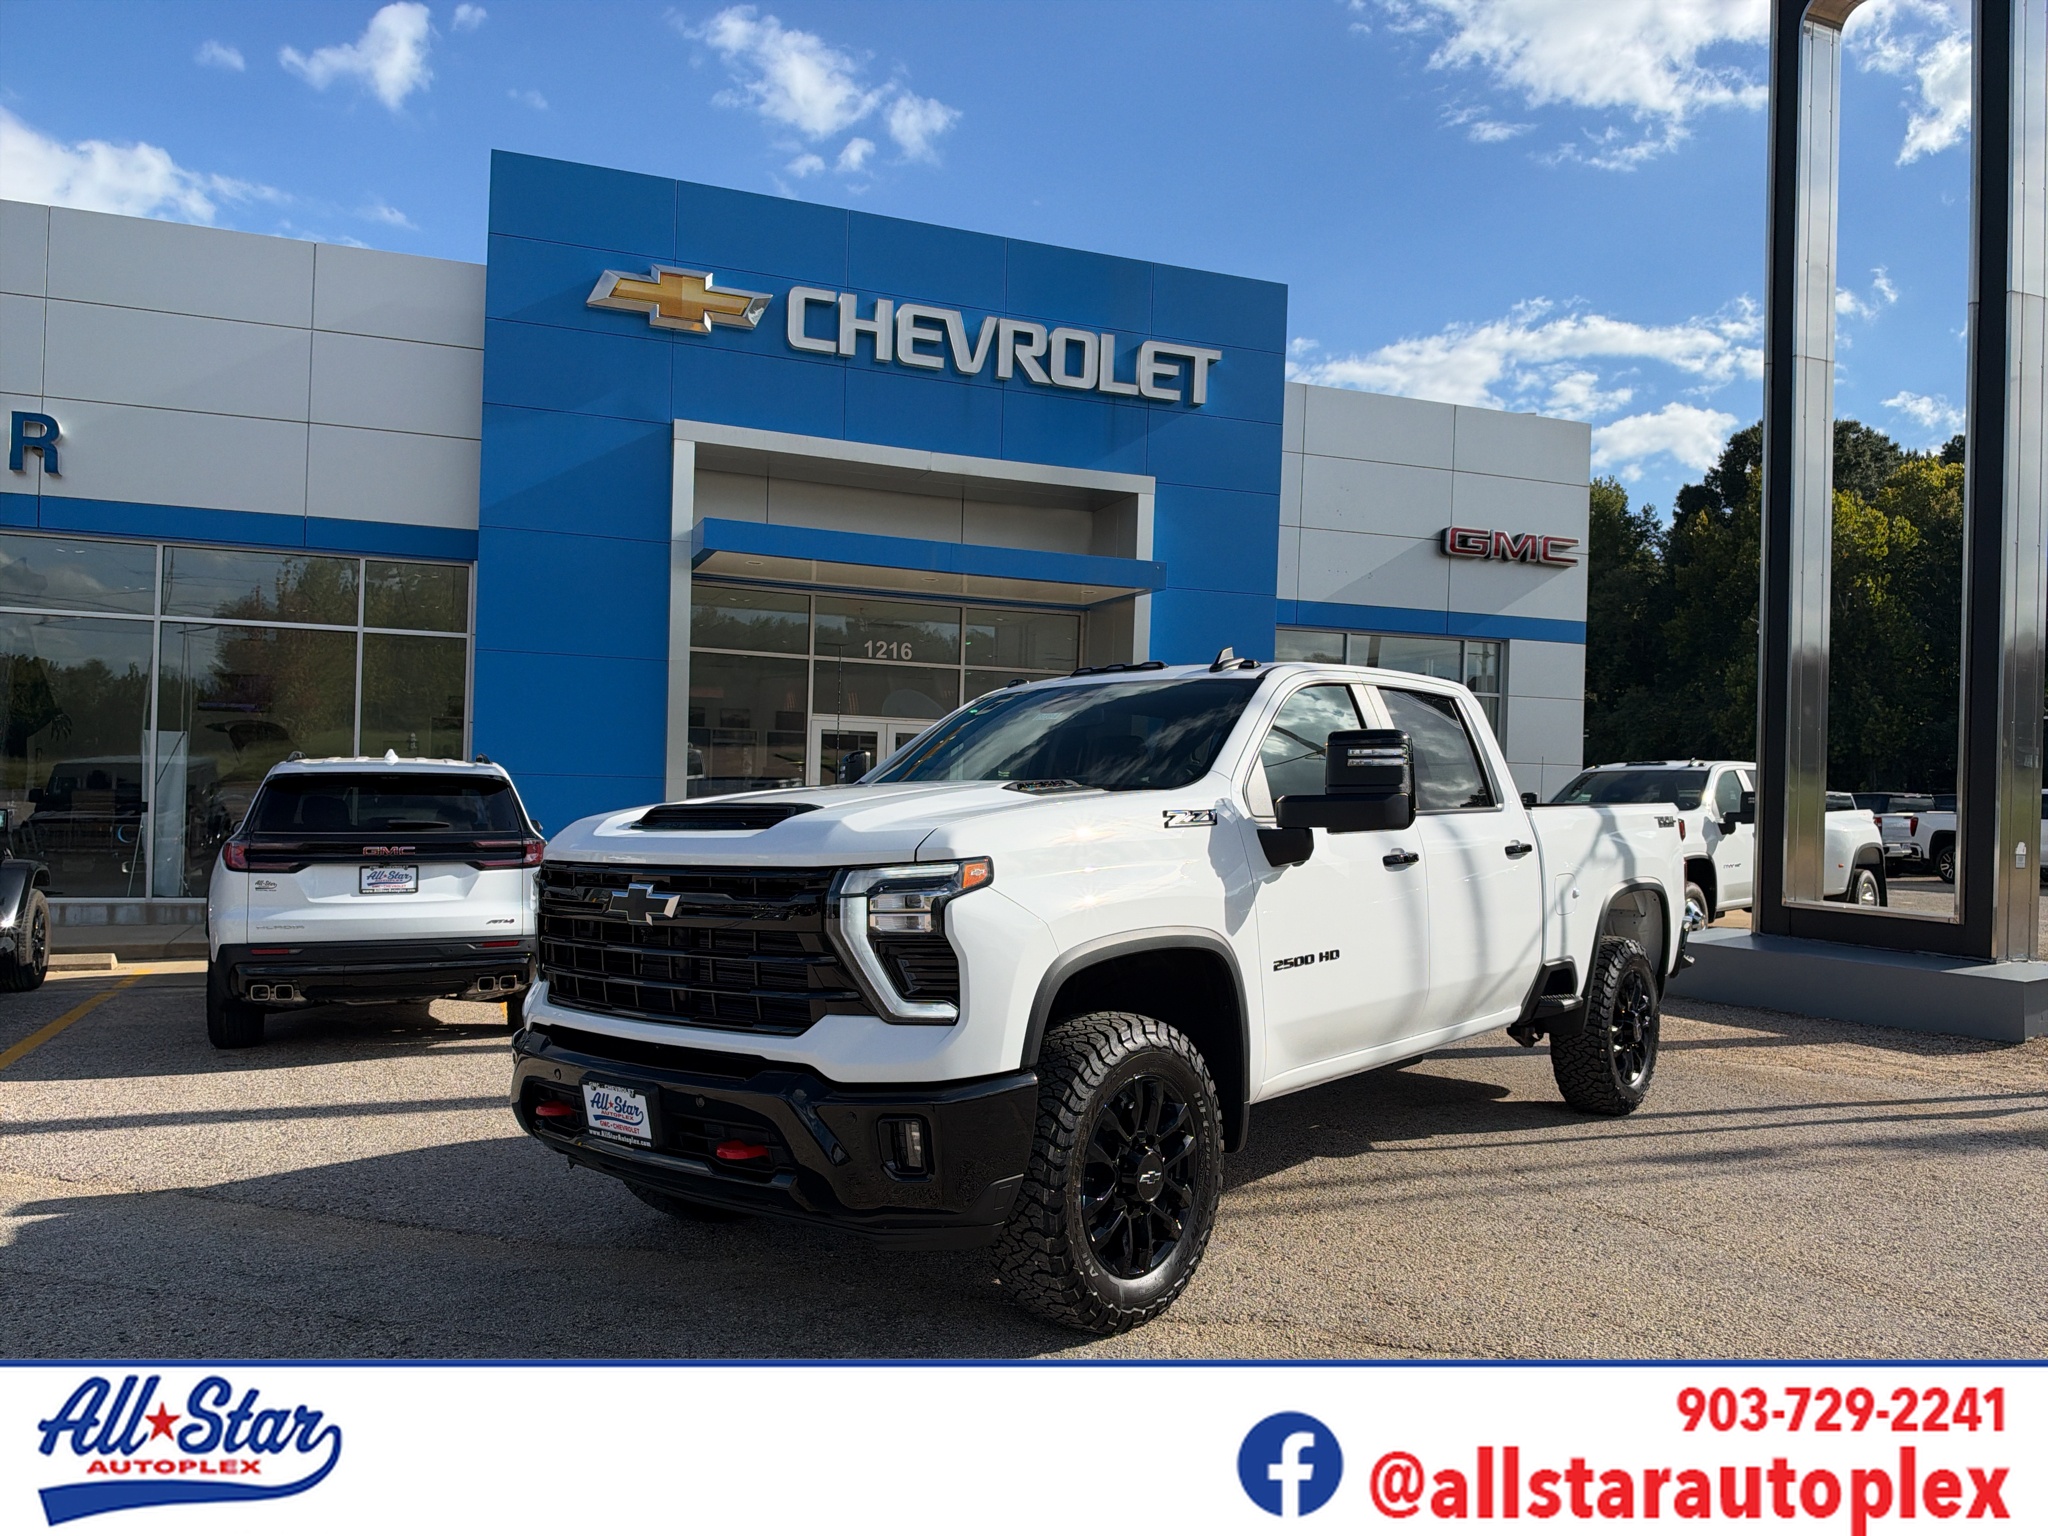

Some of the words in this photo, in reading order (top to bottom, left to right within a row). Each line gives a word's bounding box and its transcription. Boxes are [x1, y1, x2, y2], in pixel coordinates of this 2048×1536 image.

[788, 286, 1222, 404] CHEVROLET
[9, 411, 60, 475] R
[1442, 526, 1580, 566] GMC
[864, 640, 912, 660] 1216
[362, 846, 416, 856] GMC
[1273, 954, 1315, 972] 2500
[1319, 949, 1340, 963] HD
[590, 1092, 611, 1111] All
[614, 1096, 641, 1117] Star
[601, 1110, 635, 1121] AUTOPLEX
[612, 1122, 640, 1134] CHEVROLET
